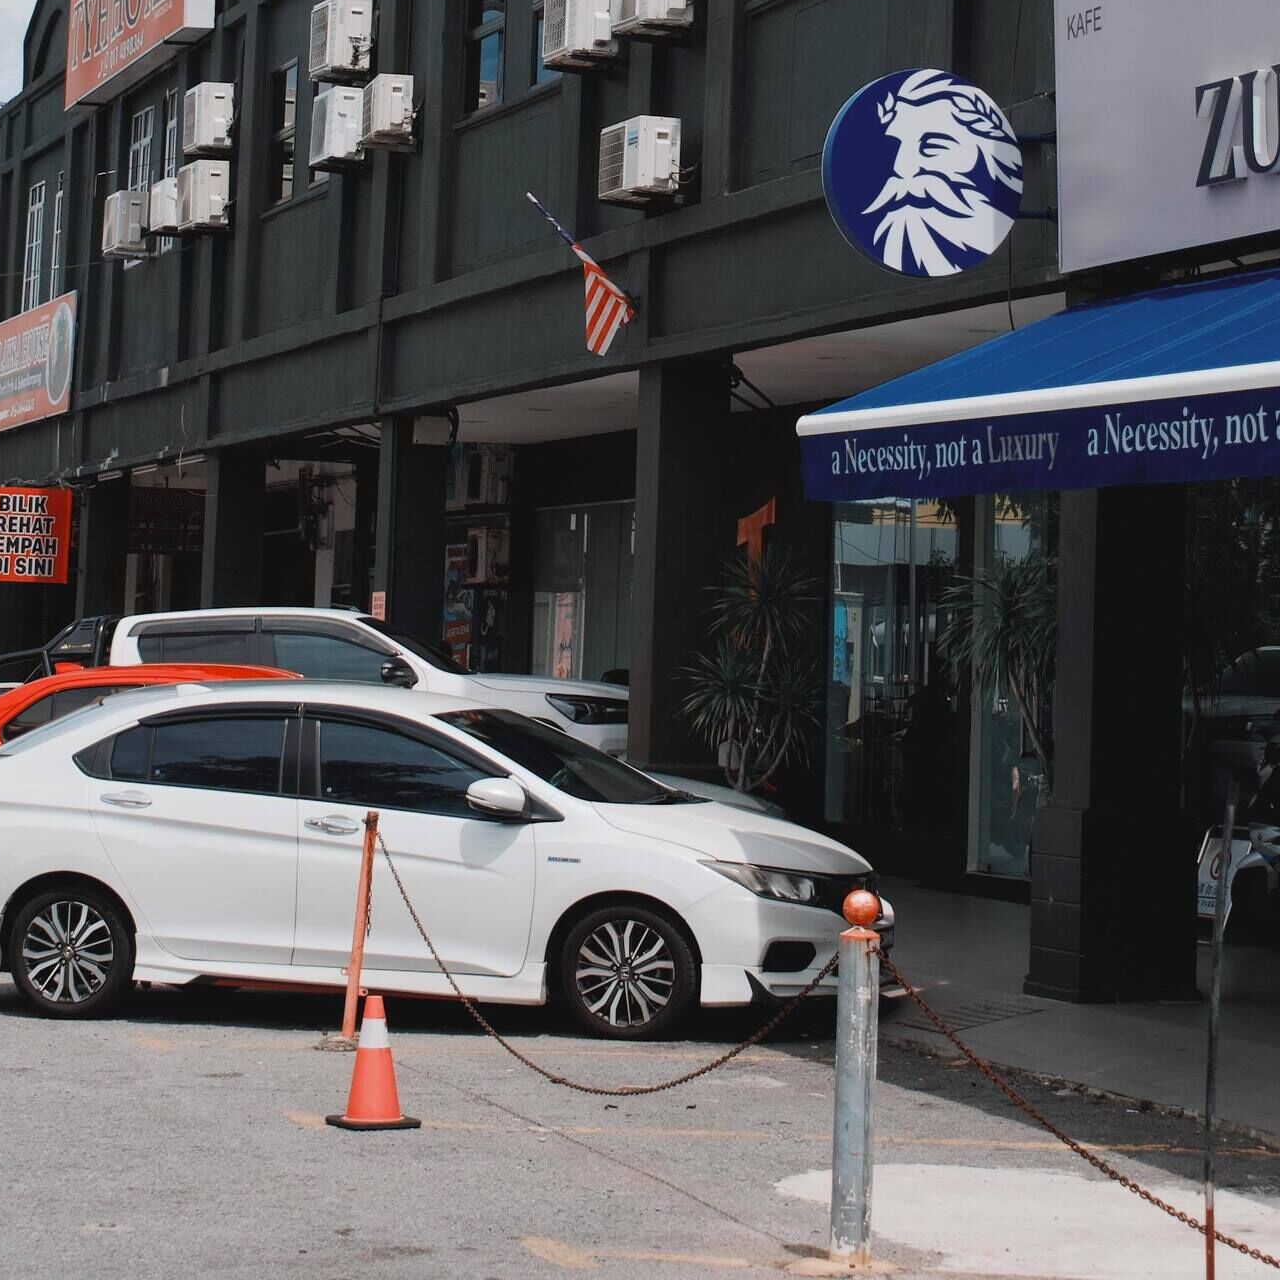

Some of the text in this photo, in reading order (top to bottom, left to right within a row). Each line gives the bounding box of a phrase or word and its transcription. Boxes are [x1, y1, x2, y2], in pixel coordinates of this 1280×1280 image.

[1066, 6, 1103, 42] KAFE
[831, 425, 1060, 480] a Necessity, not a Luxury
[1087, 427, 1099, 456] a
[1103, 406, 1219, 460] Necessity,
[1224, 403, 1269, 445] not
[14, 556, 54, 578] SINI
